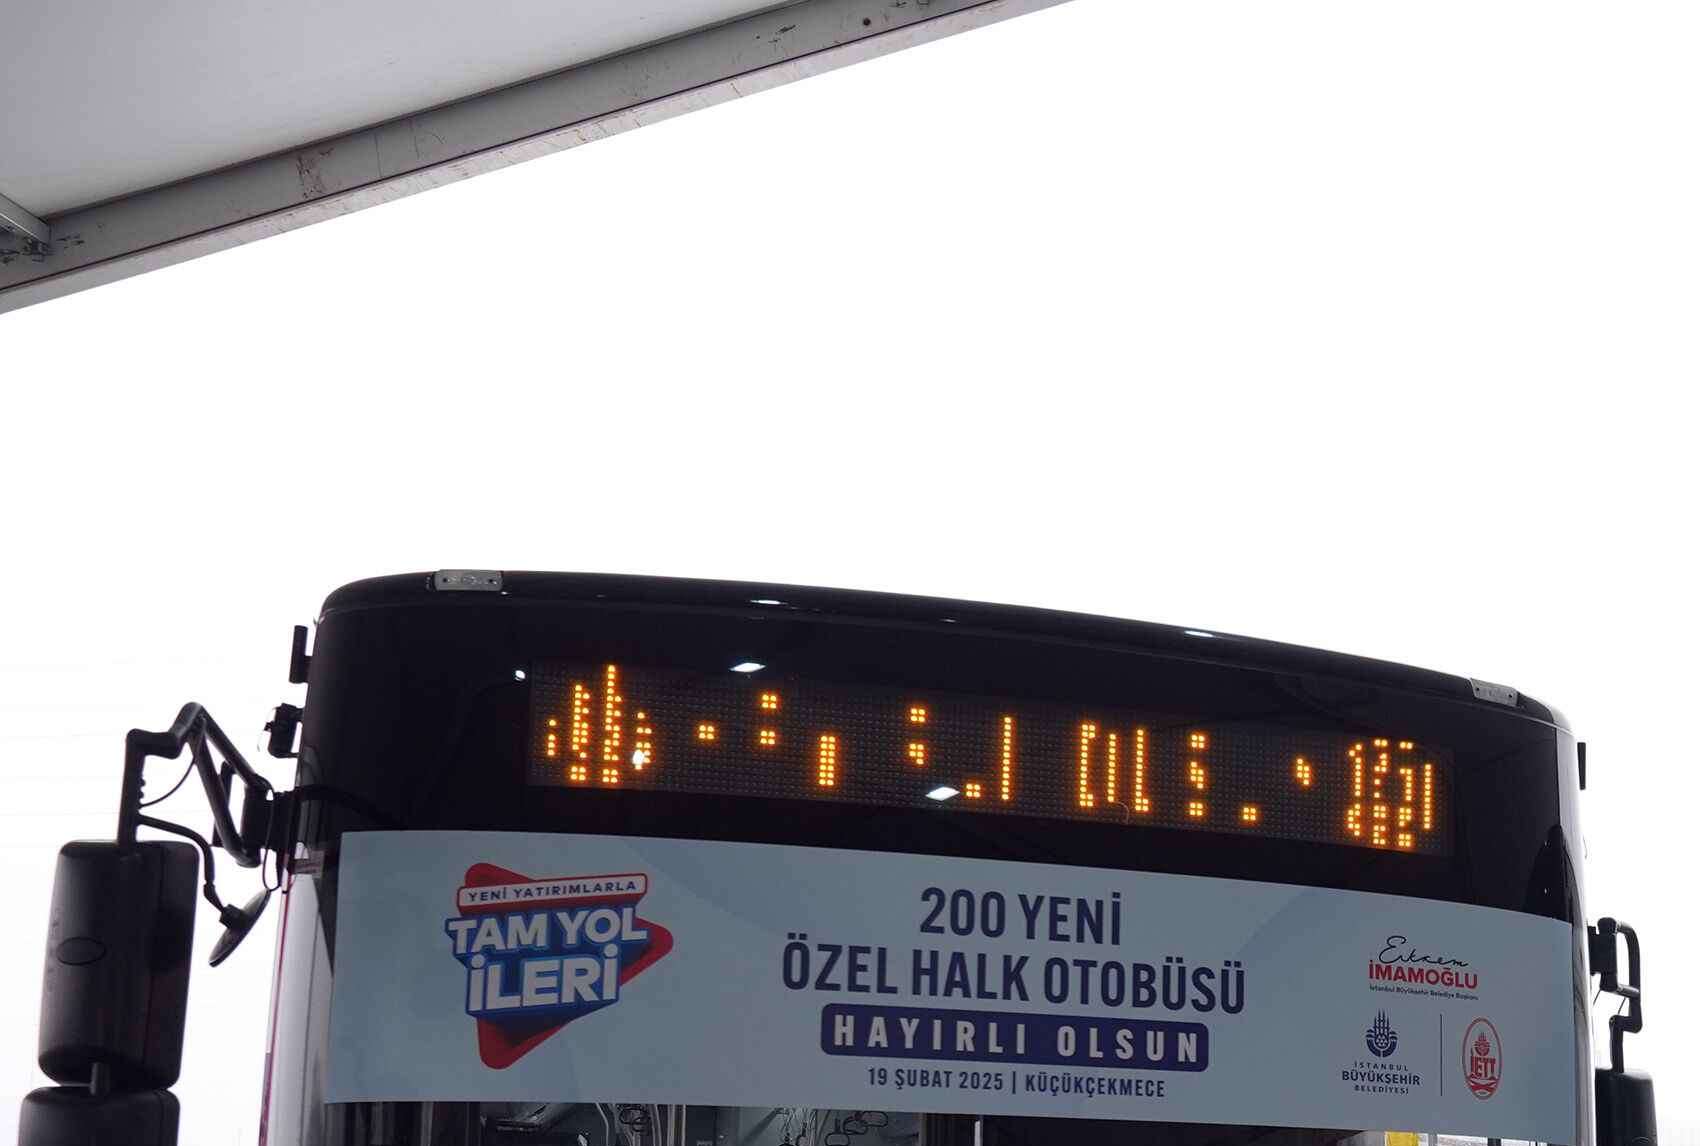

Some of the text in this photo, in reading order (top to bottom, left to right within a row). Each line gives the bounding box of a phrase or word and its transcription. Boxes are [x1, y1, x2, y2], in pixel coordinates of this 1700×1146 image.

[468, 880, 637, 903] YENİ YATIRIMLARLA
[448, 904, 648, 954] TAM YOL
[920, 887, 1121, 945] 200 YENİ
[1379, 935, 1469, 967] Ekrem
[469, 944, 617, 1012] İLERİ
[783, 933, 1245, 1014] ÖZEL HALK OTOBÜSÜ
[1369, 959, 1478, 990] İMAMOĞLU
[1369, 983, 1395, 993] İstanbul
[1396, 986, 1429, 996] Büyükşehir
[1430, 990, 1454, 999] Belediye
[834, 1014, 1198, 1063] HAYIRLI OLSUN
[1342, 1069, 1420, 1086] BÜYÜKŞEHİR
[1354, 1061, 1408, 1072] İSTANBUL
[868, 1067, 1165, 1098] 19 ŞUBAT 2025 KÜÇÜKÇEKMECE
[1354, 1084, 1409, 1095] BELEDİYESİ
